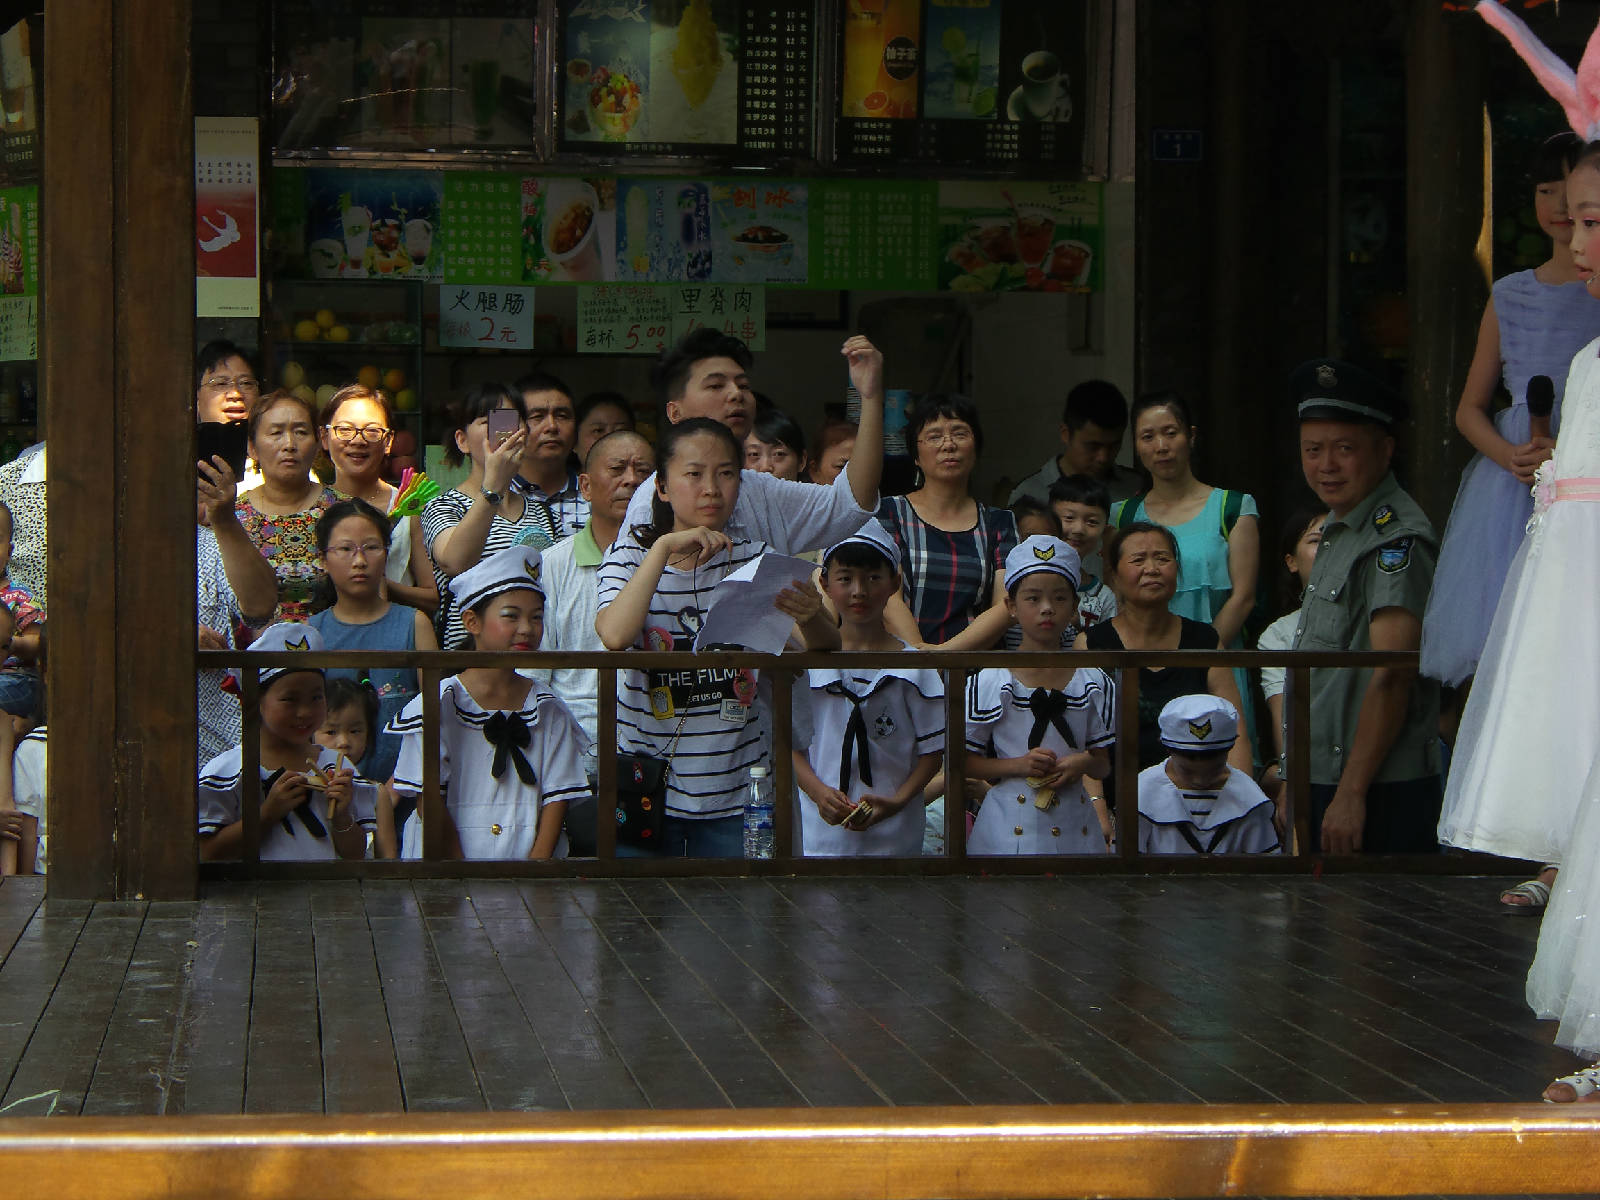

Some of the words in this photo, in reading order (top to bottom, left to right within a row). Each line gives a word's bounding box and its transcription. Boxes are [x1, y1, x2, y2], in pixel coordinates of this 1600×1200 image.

[449, 289, 525, 316] 火腿肠
[679, 286, 752, 315] 里脊肉
[585, 326, 616, 349] 每杯
[656, 670, 693, 687] THE
[701, 692, 711, 701] US
[711, 690, 723, 701] GO
